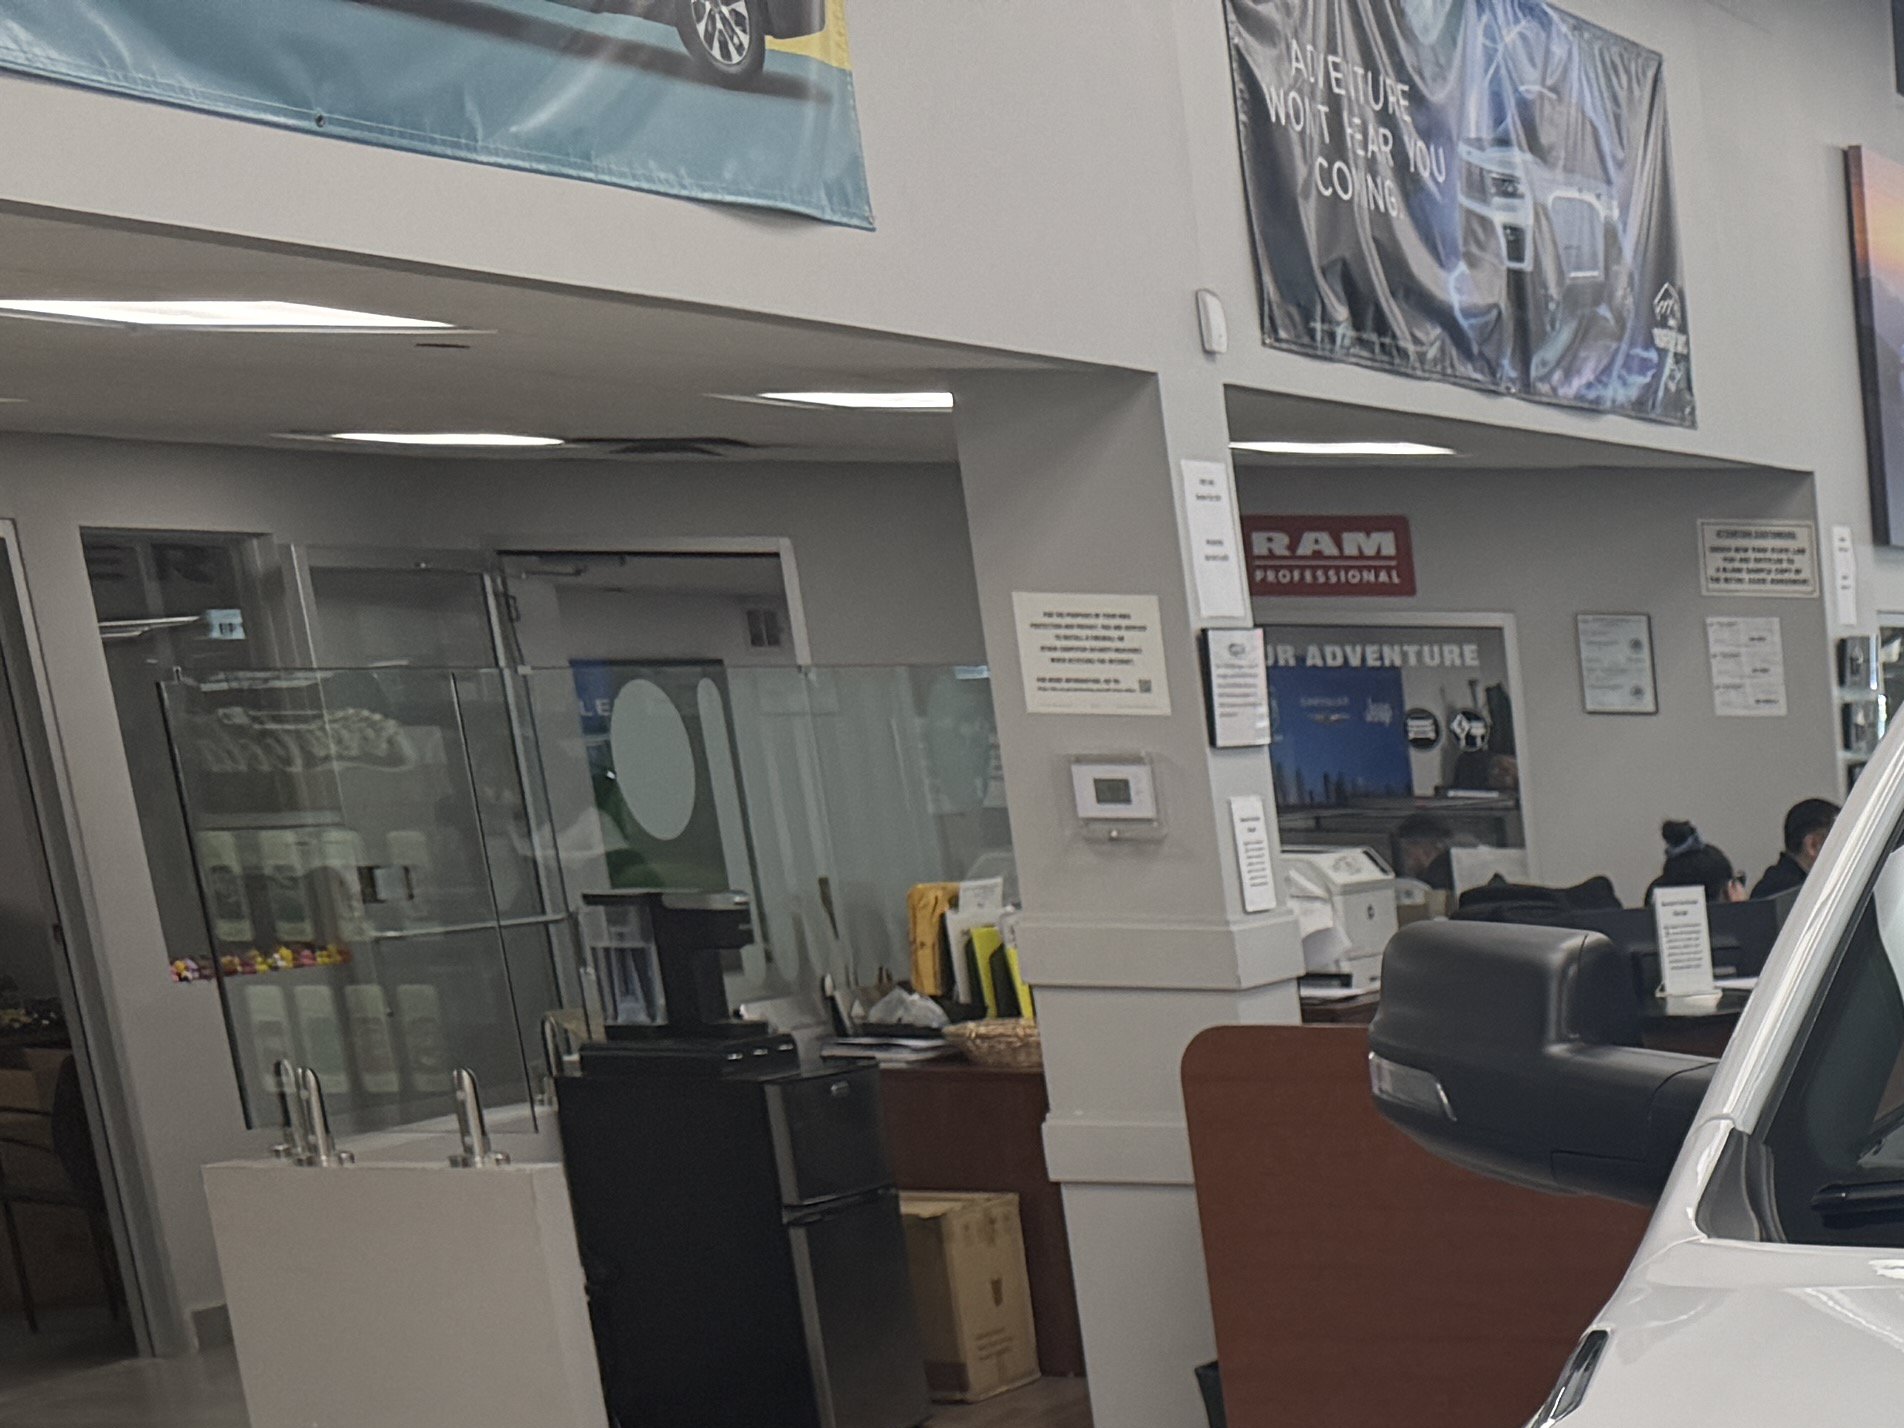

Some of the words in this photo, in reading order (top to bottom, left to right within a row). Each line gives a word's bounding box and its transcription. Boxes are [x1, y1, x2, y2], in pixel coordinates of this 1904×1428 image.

[1403, 132, 1447, 184] YOU
[1250, 530, 1397, 557] RAM
[1254, 567, 1401, 585] PROFESSIONAL
[1266, 643, 1297, 667] UR
[1305, 643, 1480, 667] ADVENTURE
